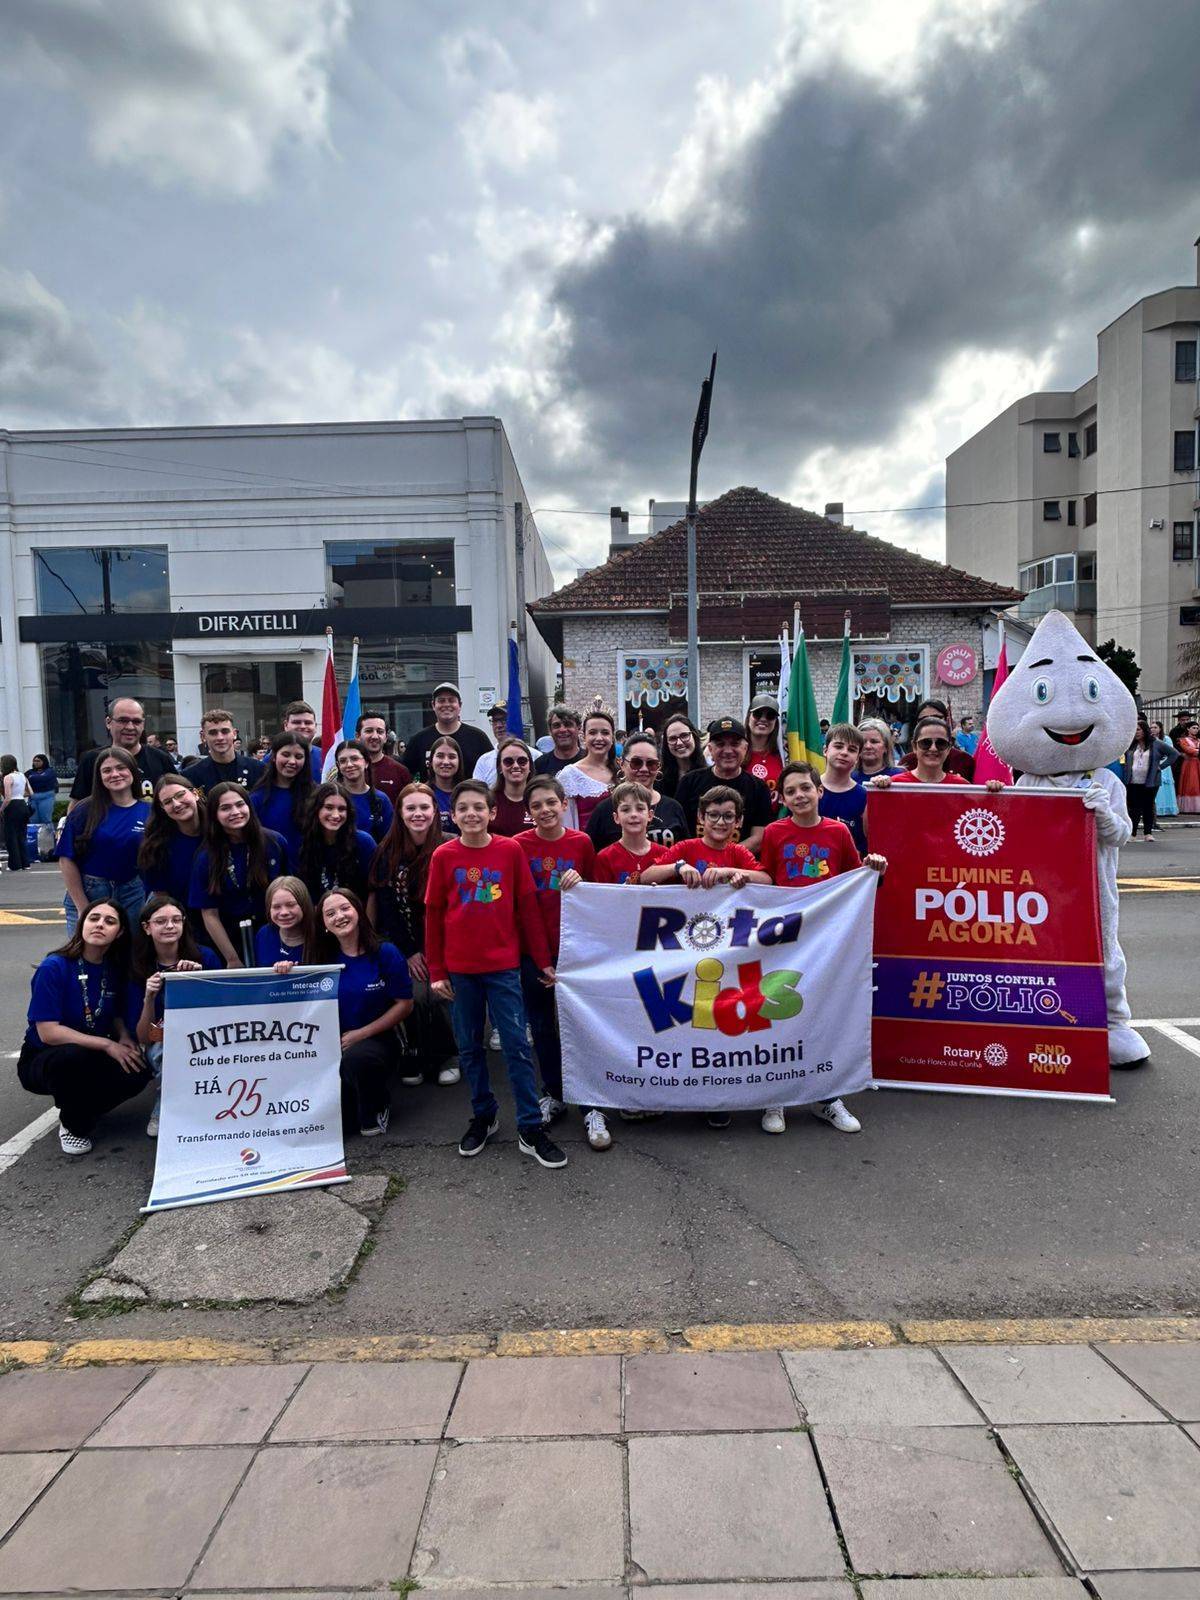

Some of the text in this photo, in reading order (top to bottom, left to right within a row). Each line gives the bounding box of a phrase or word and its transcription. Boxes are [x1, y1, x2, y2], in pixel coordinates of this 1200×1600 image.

[198, 614, 297, 632] DIFRATELLI
[942, 648, 972, 666] DONUT
[946, 667, 972, 680] SHOP
[927, 867, 1034, 885] ELIMINE A
[915, 881, 1049, 925] PÓLIO
[635, 905, 803, 951] Rota
[927, 919, 1038, 945] AGORA
[292, 982, 320, 990] Interact
[947, 973, 993, 984] JUNTOS
[995, 975, 1045, 986] CONTRA
[1047, 977, 1056, 986] A
[632, 957, 804, 1037] kids
[946, 983, 1062, 1015] PÓLIO
[187, 1020, 320, 1055] INTERACT
[189, 1049, 318, 1067] Club de Flores da Cunha
[637, 1040, 805, 1069] Per Bambini
[943, 1045, 982, 1060] Rotary
[1034, 1043, 1066, 1056] END
[899, 1056, 916, 1064] Club
[927, 1059, 947, 1067] Flores
[959, 1060, 983, 1069] Cunha
[1028, 1052, 1072, 1066] POLIO
[605, 1070, 646, 1088] Rotary
[649, 1075, 680, 1087] Club
[682, 1076, 699, 1086] de
[702, 1074, 743, 1087] Flores
[746, 1072, 762, 1083] da
[765, 1068, 807, 1082] Cunha
[816, 1060, 834, 1073] RS
[1032, 1062, 1067, 1075] NOW
[194, 1075, 310, 1121] HÁ 25 ANOS
[176, 1122, 326, 1144] Transformando ideias em ações
